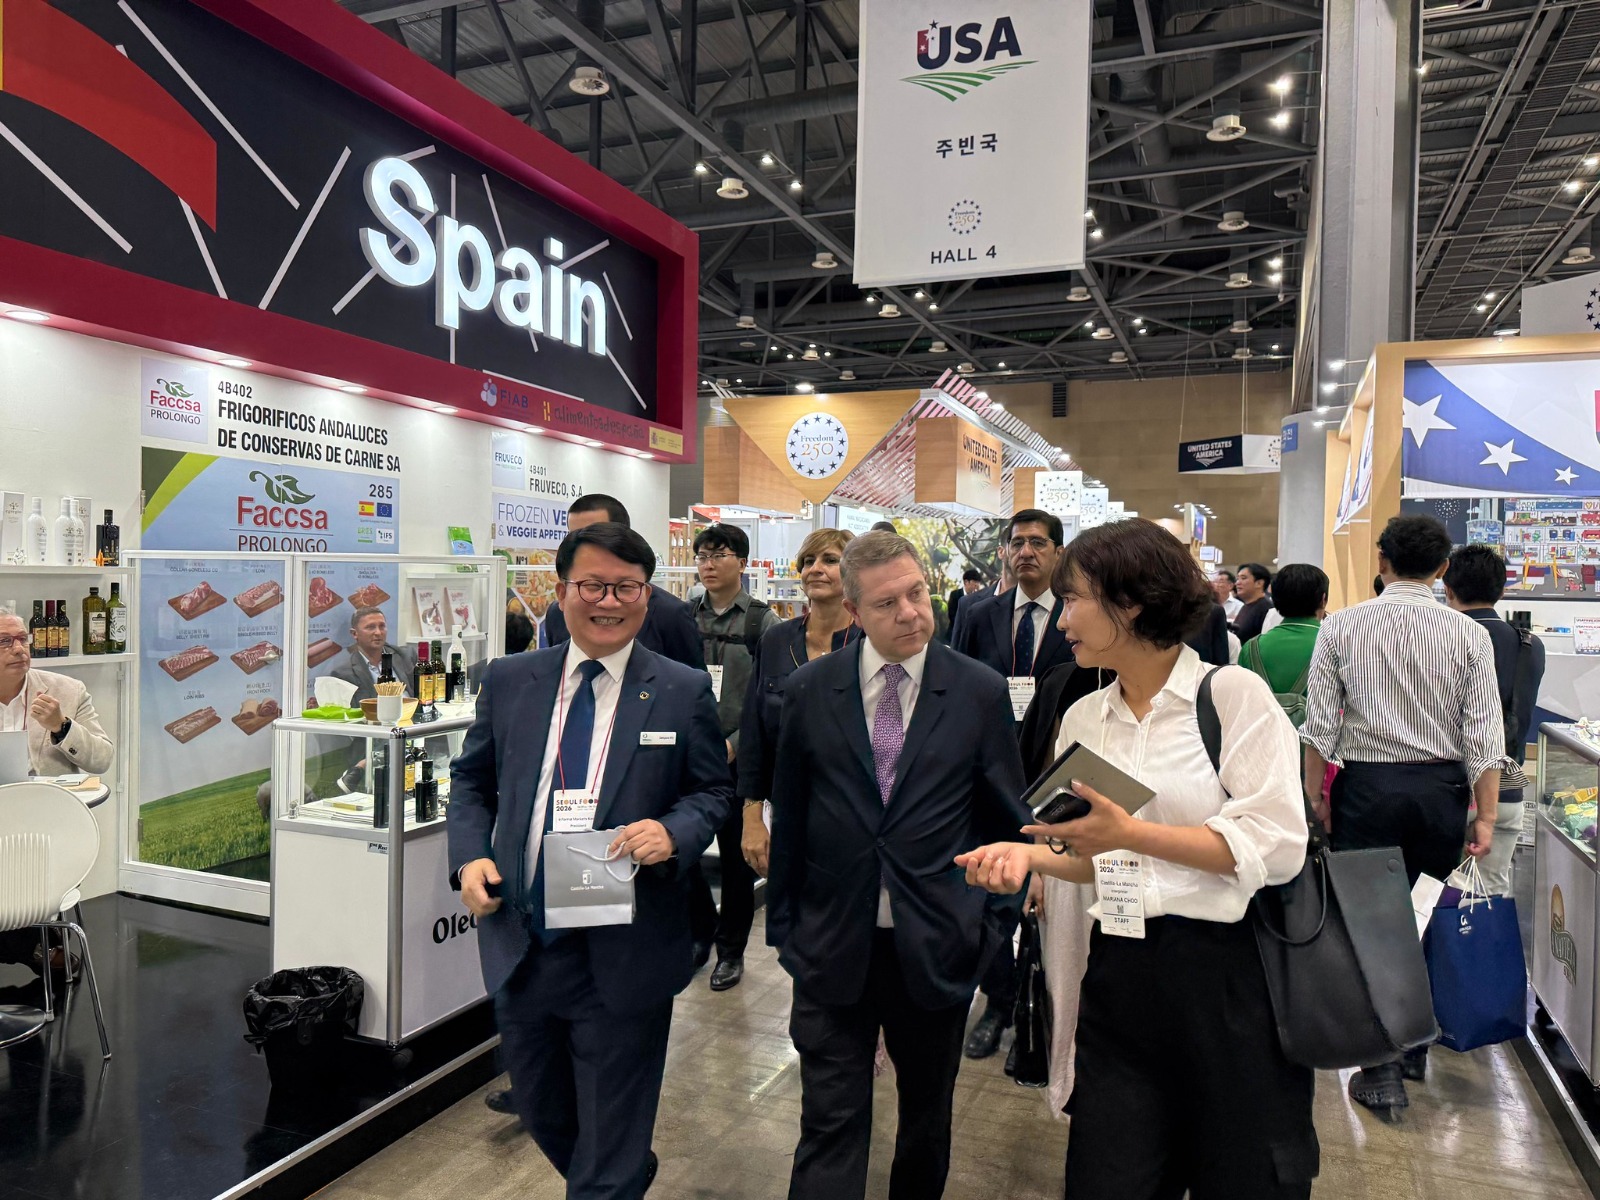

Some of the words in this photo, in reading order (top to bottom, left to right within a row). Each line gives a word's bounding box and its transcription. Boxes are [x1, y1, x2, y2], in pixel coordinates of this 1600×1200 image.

[917, 16, 1022, 70] USA
[936, 133, 998, 158] 주빈국
[955, 215, 975, 226] 250
[359, 157, 606, 357] Spain
[931, 248, 977, 264] HALL
[986, 245, 997, 259] 4
[218, 381, 253, 399] 4B402
[500, 388, 529, 408] FIAB
[150, 390, 201, 413] Faccsa
[151, 409, 201, 425] PROLONGO
[218, 399, 316, 433] FRIGORIFICOS
[319, 418, 388, 445] ANDALUCES
[800, 434, 834, 442] Freedom
[1187, 444, 1209, 452] UNITED
[1210, 440, 1232, 449] STATES
[218, 428, 237, 449] DE
[241, 432, 322, 461] CONSERVAS
[325, 445, 341, 464] DE
[345, 449, 384, 470] CARNE
[386, 455, 401, 472] SA
[801, 443, 834, 461] 250
[963, 433, 981, 457] UNITED
[982, 444, 997, 464] STATES
[1195, 449, 1224, 459] AMERICA
[495, 452, 523, 465] FRUVECO
[970, 457, 991, 479] AMERICA
[369, 483, 393, 499] 285
[529, 477, 569, 498] FRUVECO,
[1047, 492, 1068, 503] 250
[237, 496, 328, 530] Faccsa
[498, 502, 549, 524] FROZEN
[553, 509, 567, 526] VE
[498, 524, 504, 536] &
[507, 526, 537, 538] VEGGIE
[539, 529, 568, 540] APPETIZ
[238, 535, 327, 552] PROLONGO
